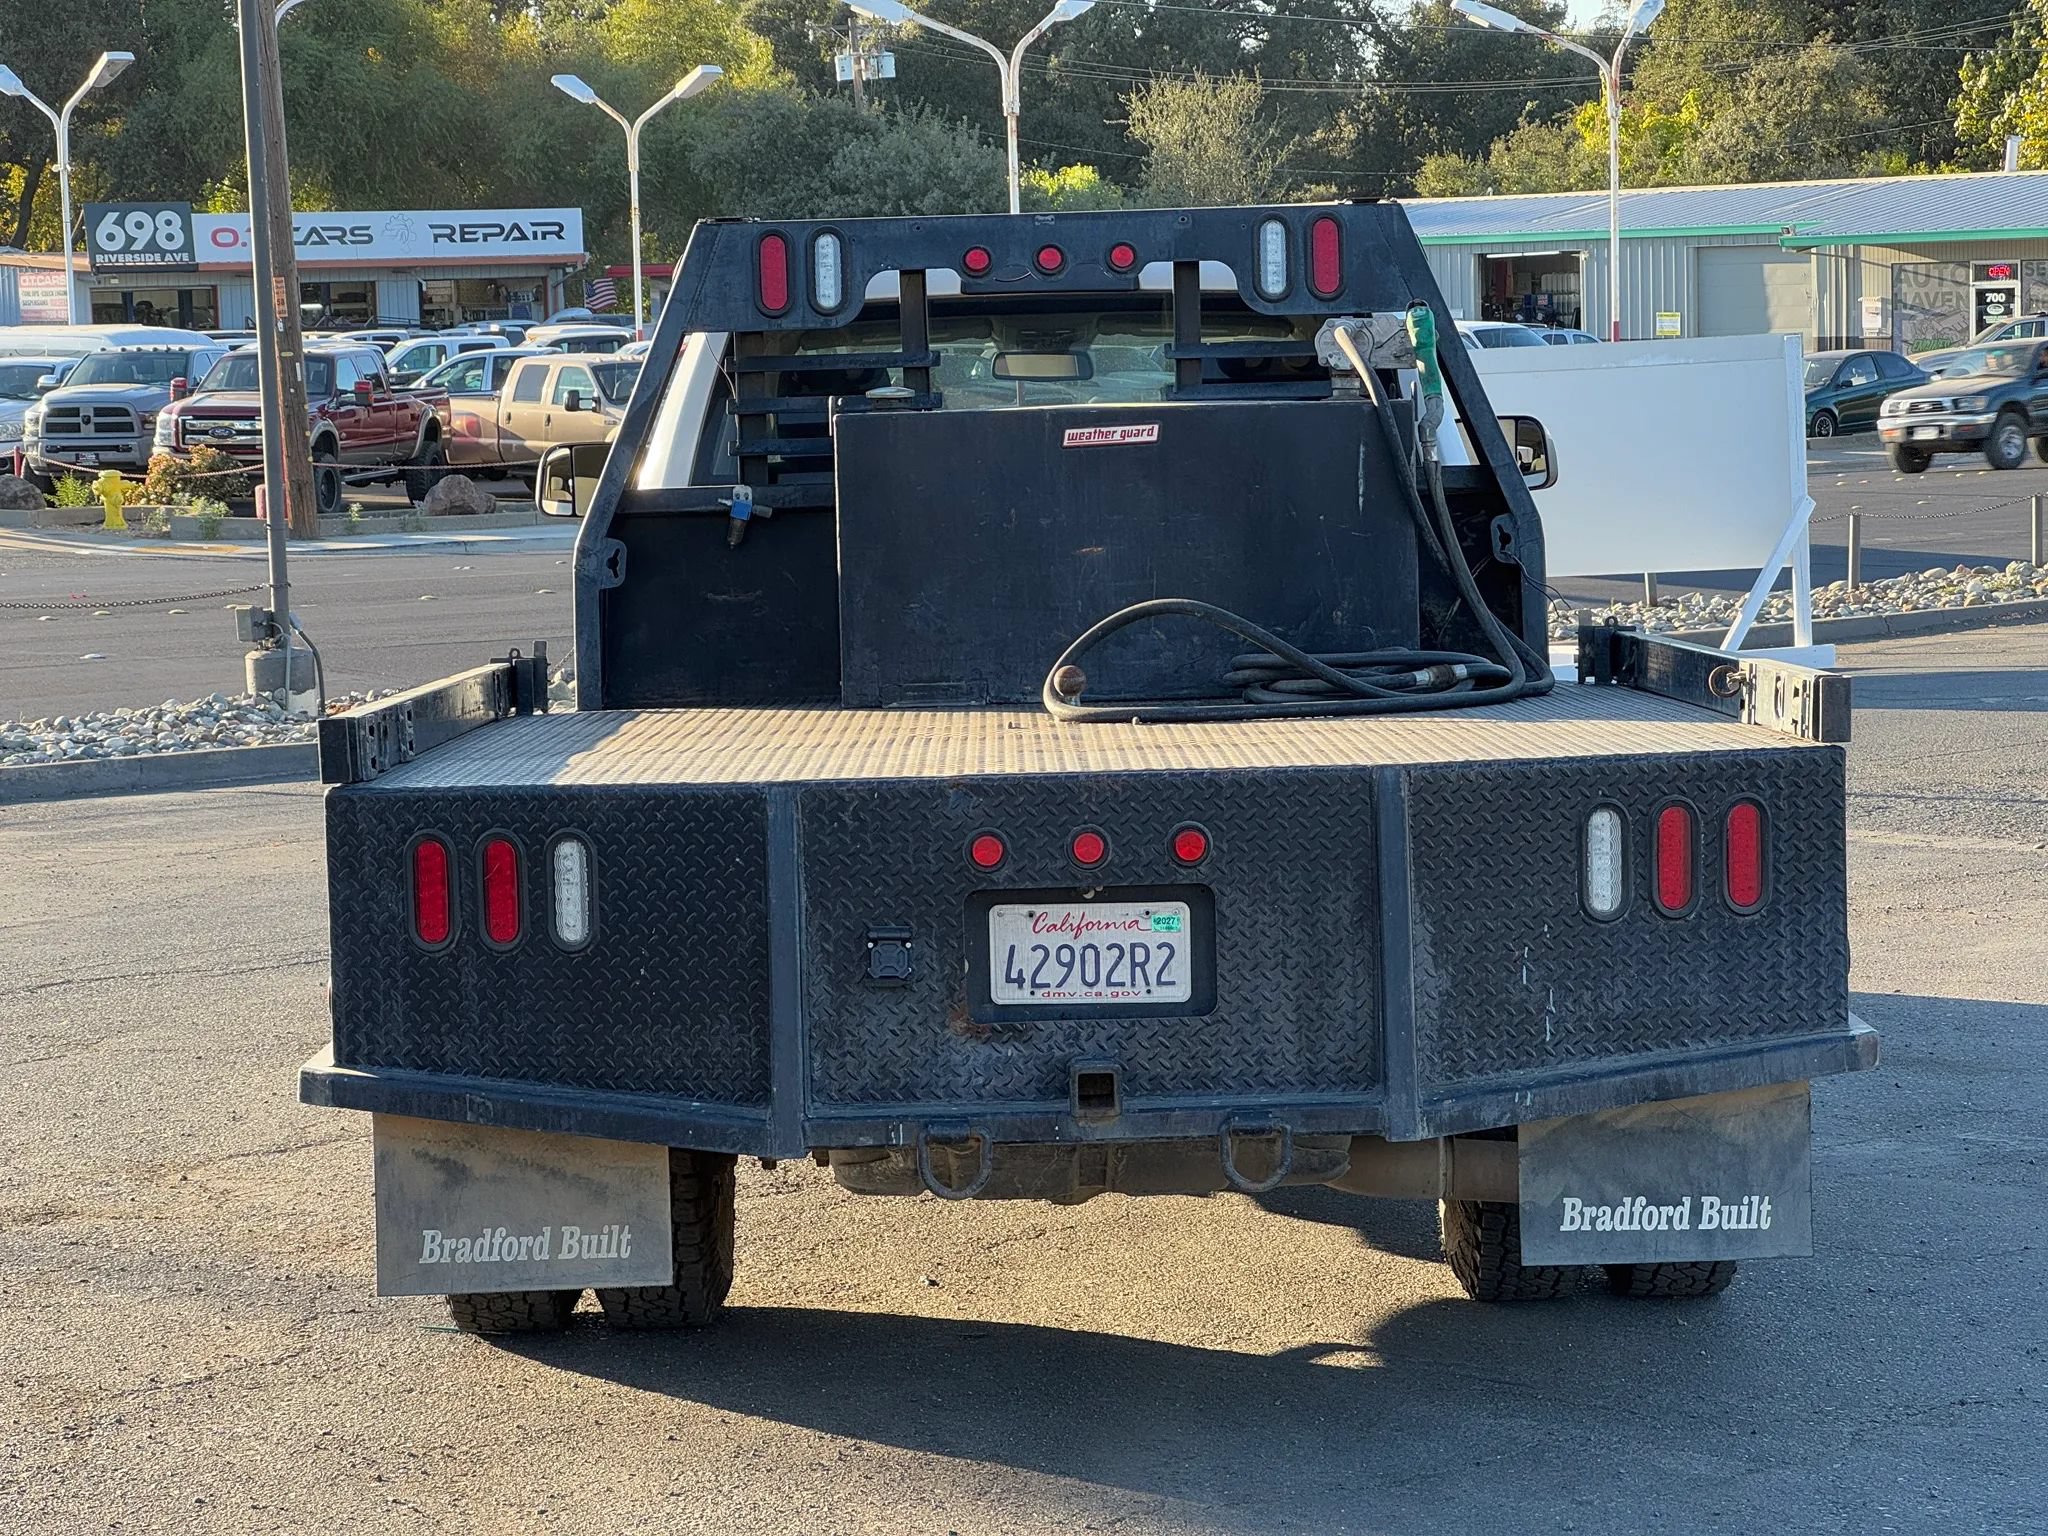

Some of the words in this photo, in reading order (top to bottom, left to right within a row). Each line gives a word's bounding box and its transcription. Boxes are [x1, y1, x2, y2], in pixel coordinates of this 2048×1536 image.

[95, 210, 184, 251] 698
[428, 221, 566, 243] REPAIR
[95, 252, 161, 263] RIVERSIDE
[164, 252, 189, 262] AVE
[1893, 263, 1968, 289] AUTO
[1988, 265, 2011, 277] OPEN
[1893, 291, 1970, 311] HAVEN
[1985, 293, 2006, 303] 700
[1067, 429, 1117, 441] weather
[1119, 426, 1155, 441] guard
[1032, 911, 1151, 940] California
[1156, 916, 1176, 925] 2027
[1005, 941, 1176, 989] 42902R2
[1041, 990, 1141, 998] dmv.ca.gov
[1560, 1196, 1691, 1231] Bradford
[1698, 1195, 1772, 1230] Built
[419, 1226, 552, 1264] Bradford
[558, 1224, 632, 1260] Built
